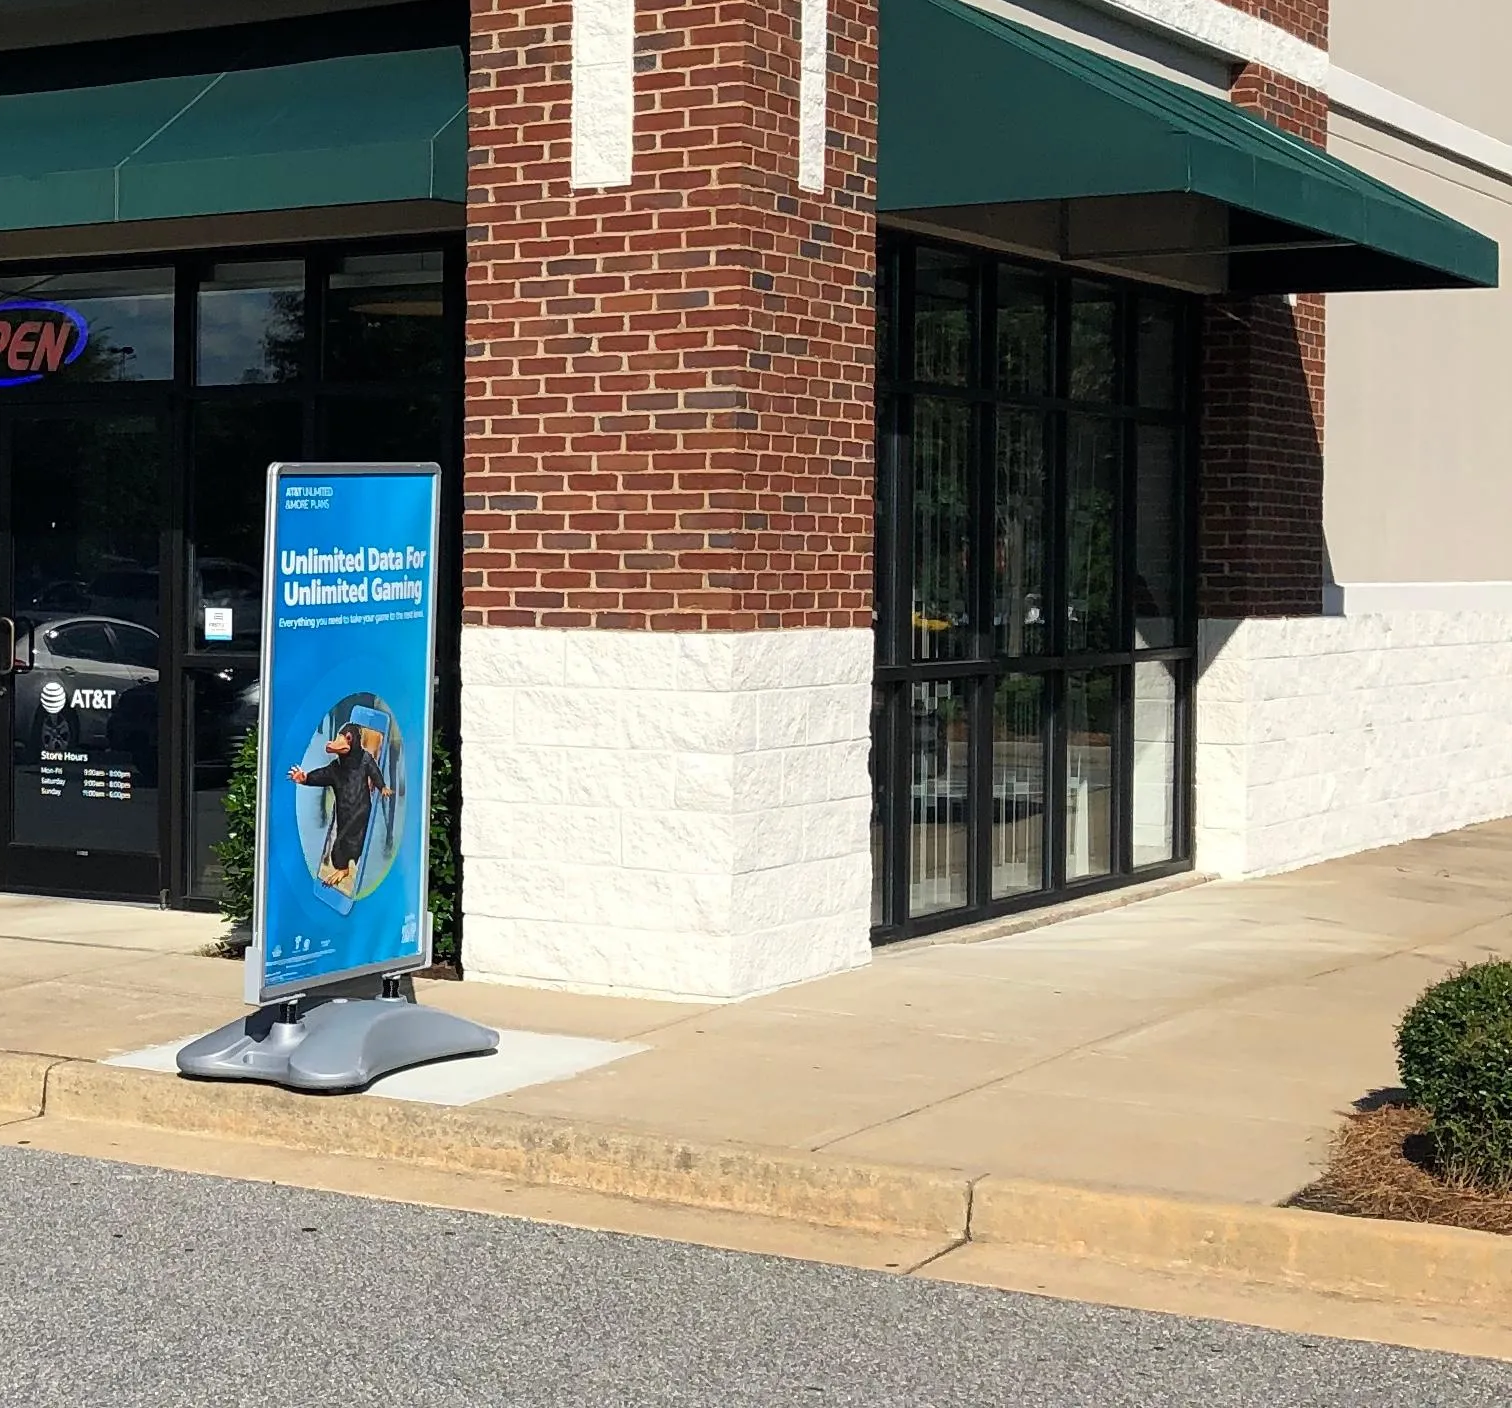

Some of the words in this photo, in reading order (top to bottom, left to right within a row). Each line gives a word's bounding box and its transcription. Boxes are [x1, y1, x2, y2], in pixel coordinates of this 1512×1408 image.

[310, 499, 330, 510] PLANS
[281, 546, 365, 575] Unlimited
[367, 547, 403, 571] Data
[405, 545, 426, 569] For
[284, 576, 368, 606] Unlimited
[371, 574, 422, 605] Gaming
[278, 616, 316, 630] Everything
[316, 617, 328, 628] you
[70, 688, 116, 710] AT&T
[41, 750, 64, 761] Store
[64, 752, 88, 762] Hours
